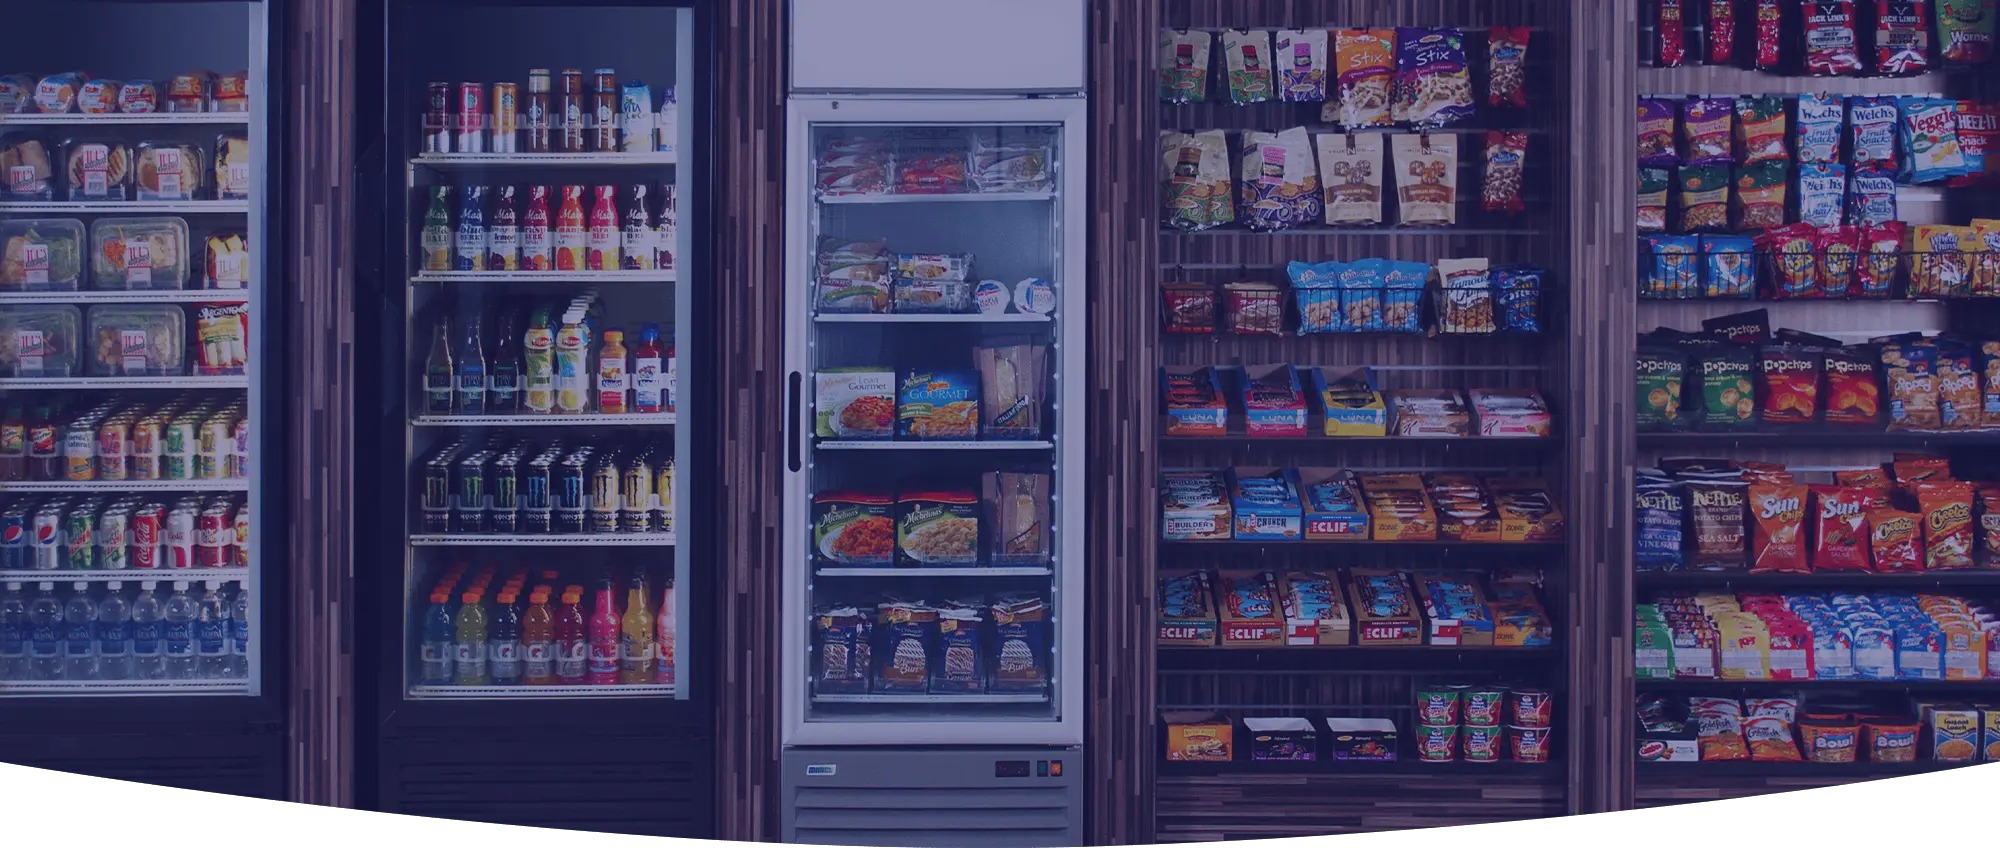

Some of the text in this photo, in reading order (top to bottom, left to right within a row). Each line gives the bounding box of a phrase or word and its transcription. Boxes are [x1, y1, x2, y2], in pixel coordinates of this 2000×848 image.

[1808, 14, 1849, 23] JACK LINK'S
[1881, 15, 1920, 23] JACK LINK'S
[1951, 31, 1989, 43] Worms
[1350, 52, 1383, 68] Stix
[1415, 48, 1450, 66] Stix
[1854, 108, 1894, 121] Welch's
[1906, 107, 1956, 134] Veggie
[1865, 127, 1886, 136] Fruit
[1959, 135, 1987, 145] Snack
[1965, 145, 1982, 156] Mix
[1859, 178, 1893, 191] Welch's
[1704, 360, 1749, 375] popchips
[1763, 359, 1812, 373] popchips
[859, 375, 879, 383] Lean
[848, 382, 887, 390] Gourmet
[1182, 413, 1214, 421] LUNA
[1341, 413, 1373, 421] LUNA
[1692, 489, 1743, 507] KETTLE
[1761, 496, 1799, 519] Sun
[1822, 498, 1860, 518] Sun
[1694, 514, 1743, 522] POTATO CHIPS
[1780, 509, 1804, 522] Chips
[1930, 504, 1970, 529] Cheetos
[1257, 517, 1287, 528] CRUNCH
[1317, 522, 1348, 533] CLIF
[1878, 519, 1914, 540] Cheetos
[1699, 534, 1739, 543] SEA SALT
[1638, 541, 1680, 552] VINEGAR
[1166, 627, 1196, 638] CLIF
[1235, 629, 1264, 639] CLIF
[1372, 628, 1402, 638] CLIF
[1699, 719, 1731, 732] Goldfish
[1748, 727, 1779, 738] Goldfish
[1816, 733, 1854, 748] Bowl
[1877, 732, 1914, 748] Bowl
